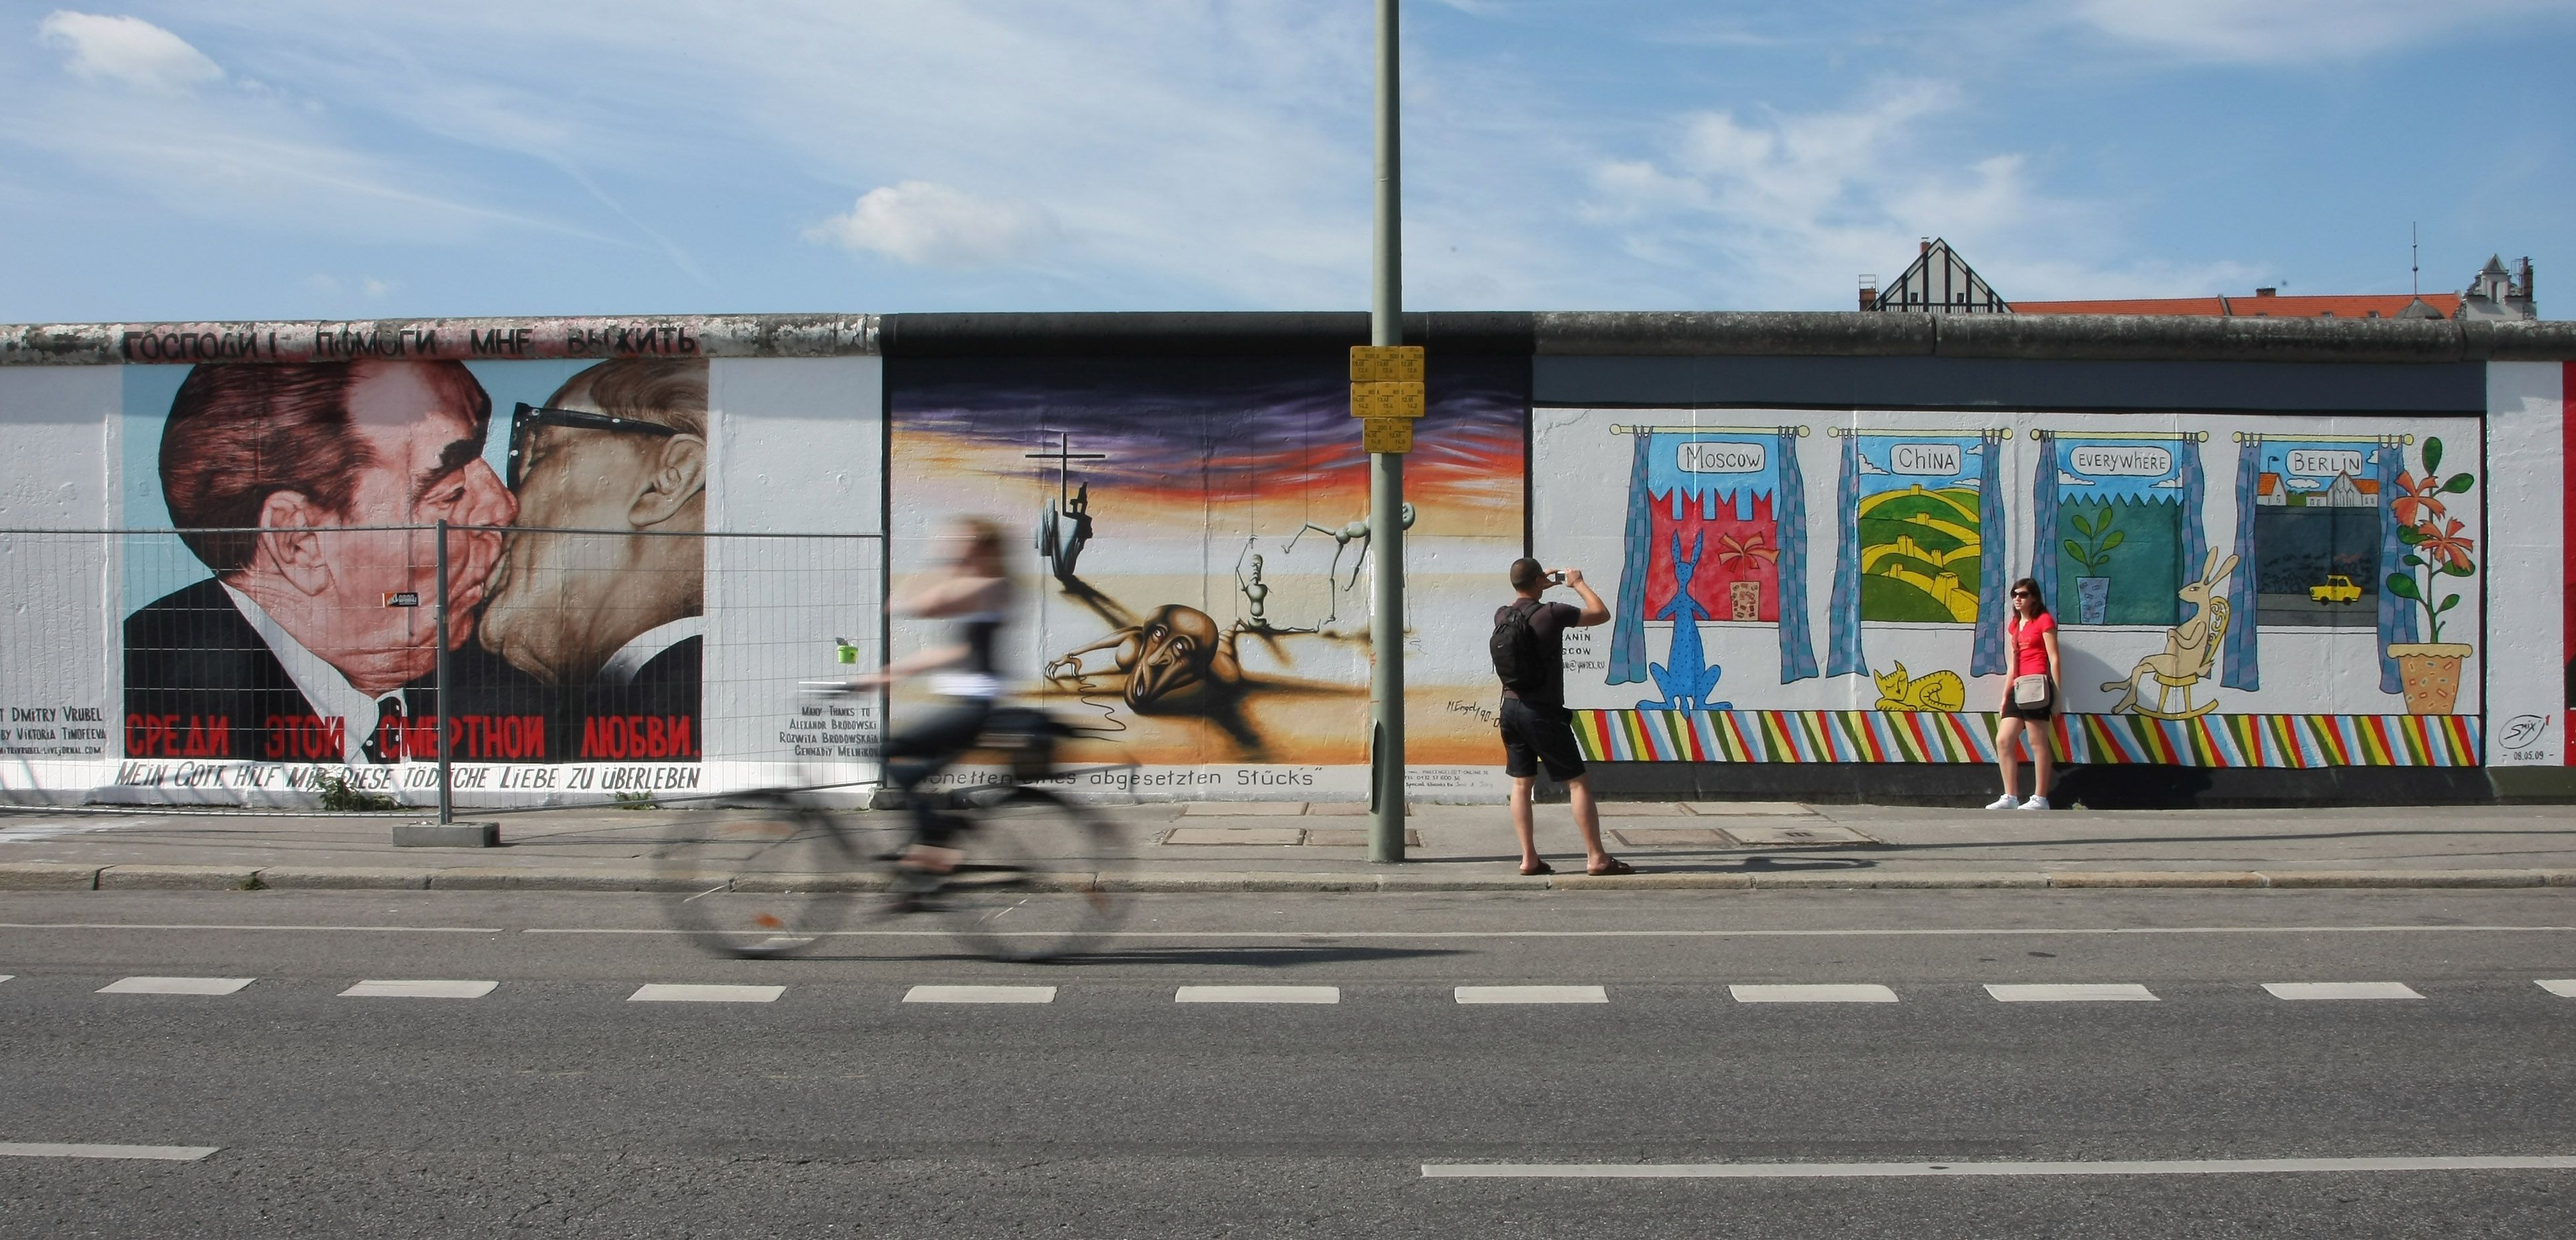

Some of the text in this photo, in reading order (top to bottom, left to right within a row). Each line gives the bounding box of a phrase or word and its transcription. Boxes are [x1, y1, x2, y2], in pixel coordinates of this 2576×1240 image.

[126, 714, 229, 757] СРЕДИ
[566, 767, 595, 790] ZU
[1090, 770, 1221, 790] abgesetzten
